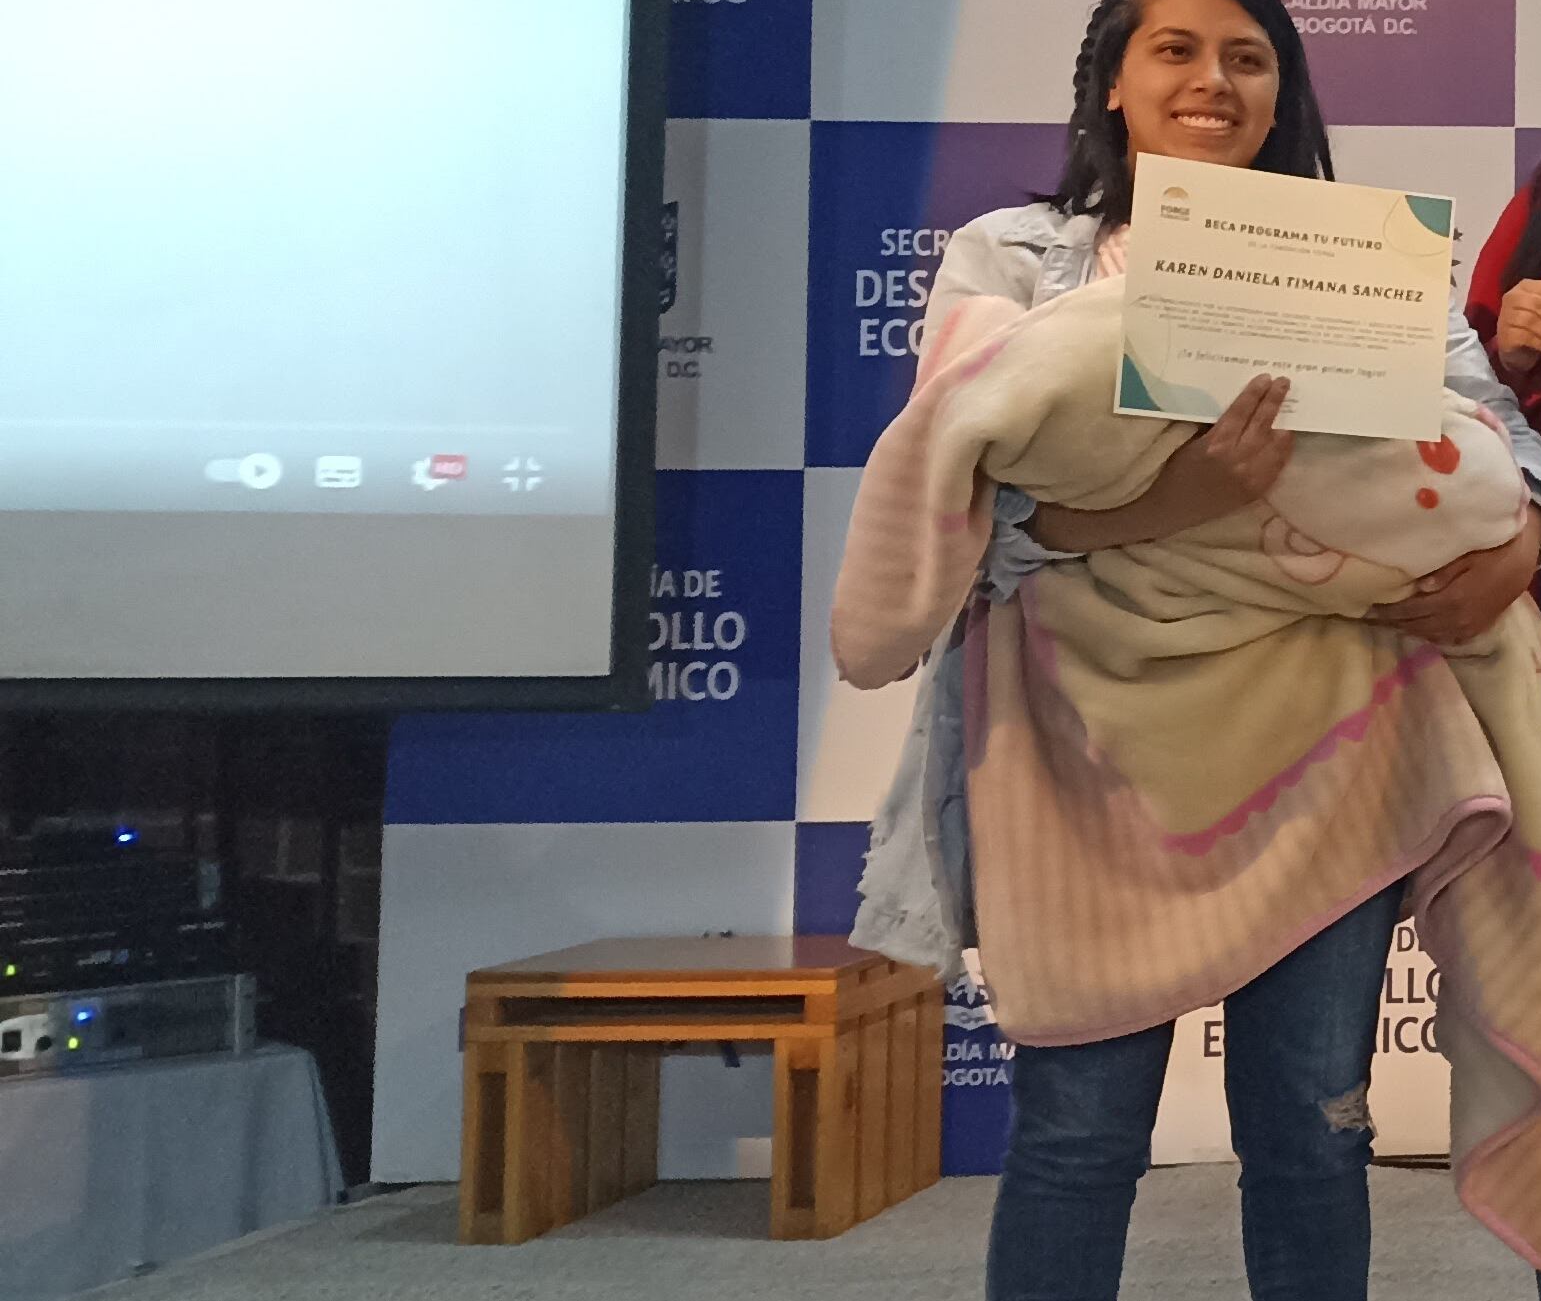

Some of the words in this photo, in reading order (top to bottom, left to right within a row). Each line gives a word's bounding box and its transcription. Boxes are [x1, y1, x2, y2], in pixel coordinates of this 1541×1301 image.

[1205, 218, 1236, 232] BECA
[1240, 223, 1309, 242] PROGRAMA
[1314, 233, 1330, 245] TU
[1333, 236, 1384, 251] FUTURO
[1155, 259, 1208, 277] KAREN
[1212, 267, 1281, 288] DANIELA
[1352, 284, 1425, 303] SANCHEZ
[684, 569, 722, 598] DE
